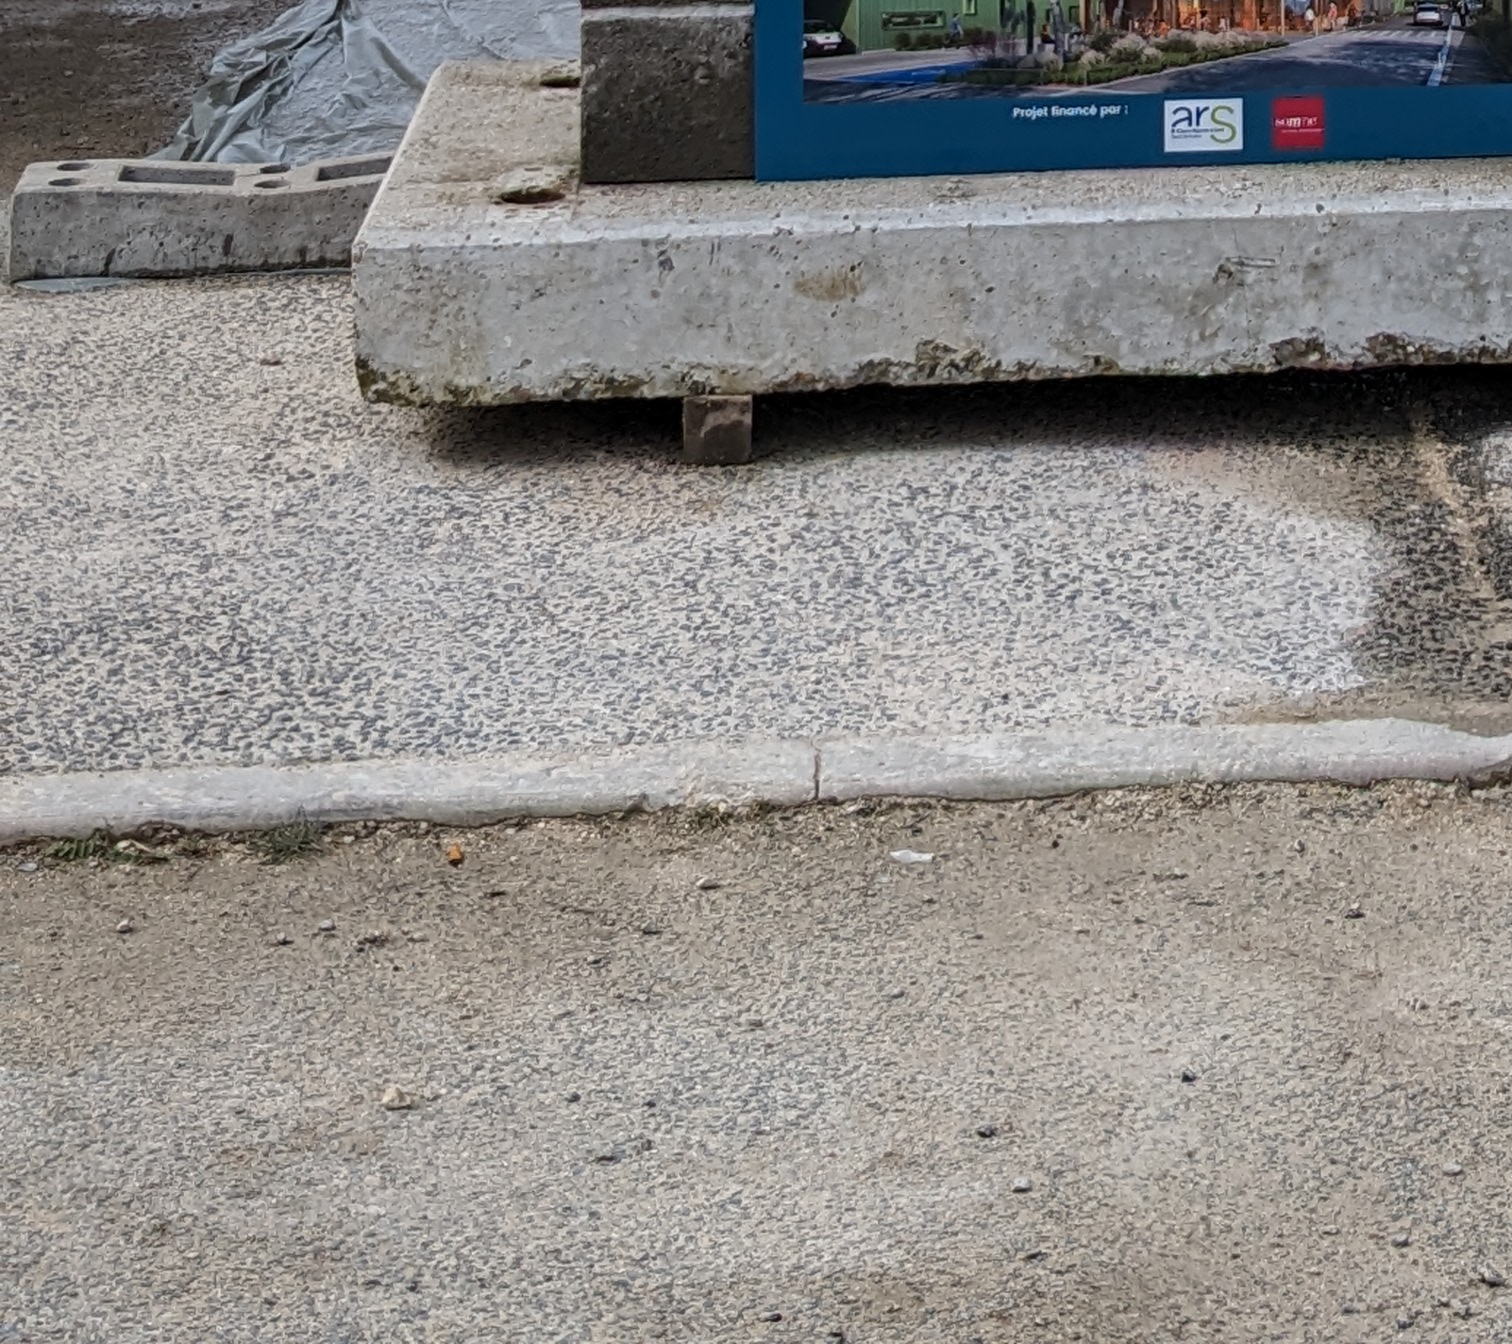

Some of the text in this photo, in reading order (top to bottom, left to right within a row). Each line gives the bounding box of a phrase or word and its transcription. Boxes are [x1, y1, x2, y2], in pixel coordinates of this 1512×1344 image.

[1013, 105, 1048, 120] Projet
[1051, 104, 1097, 116] financé
[1100, 105, 1121, 119] par
